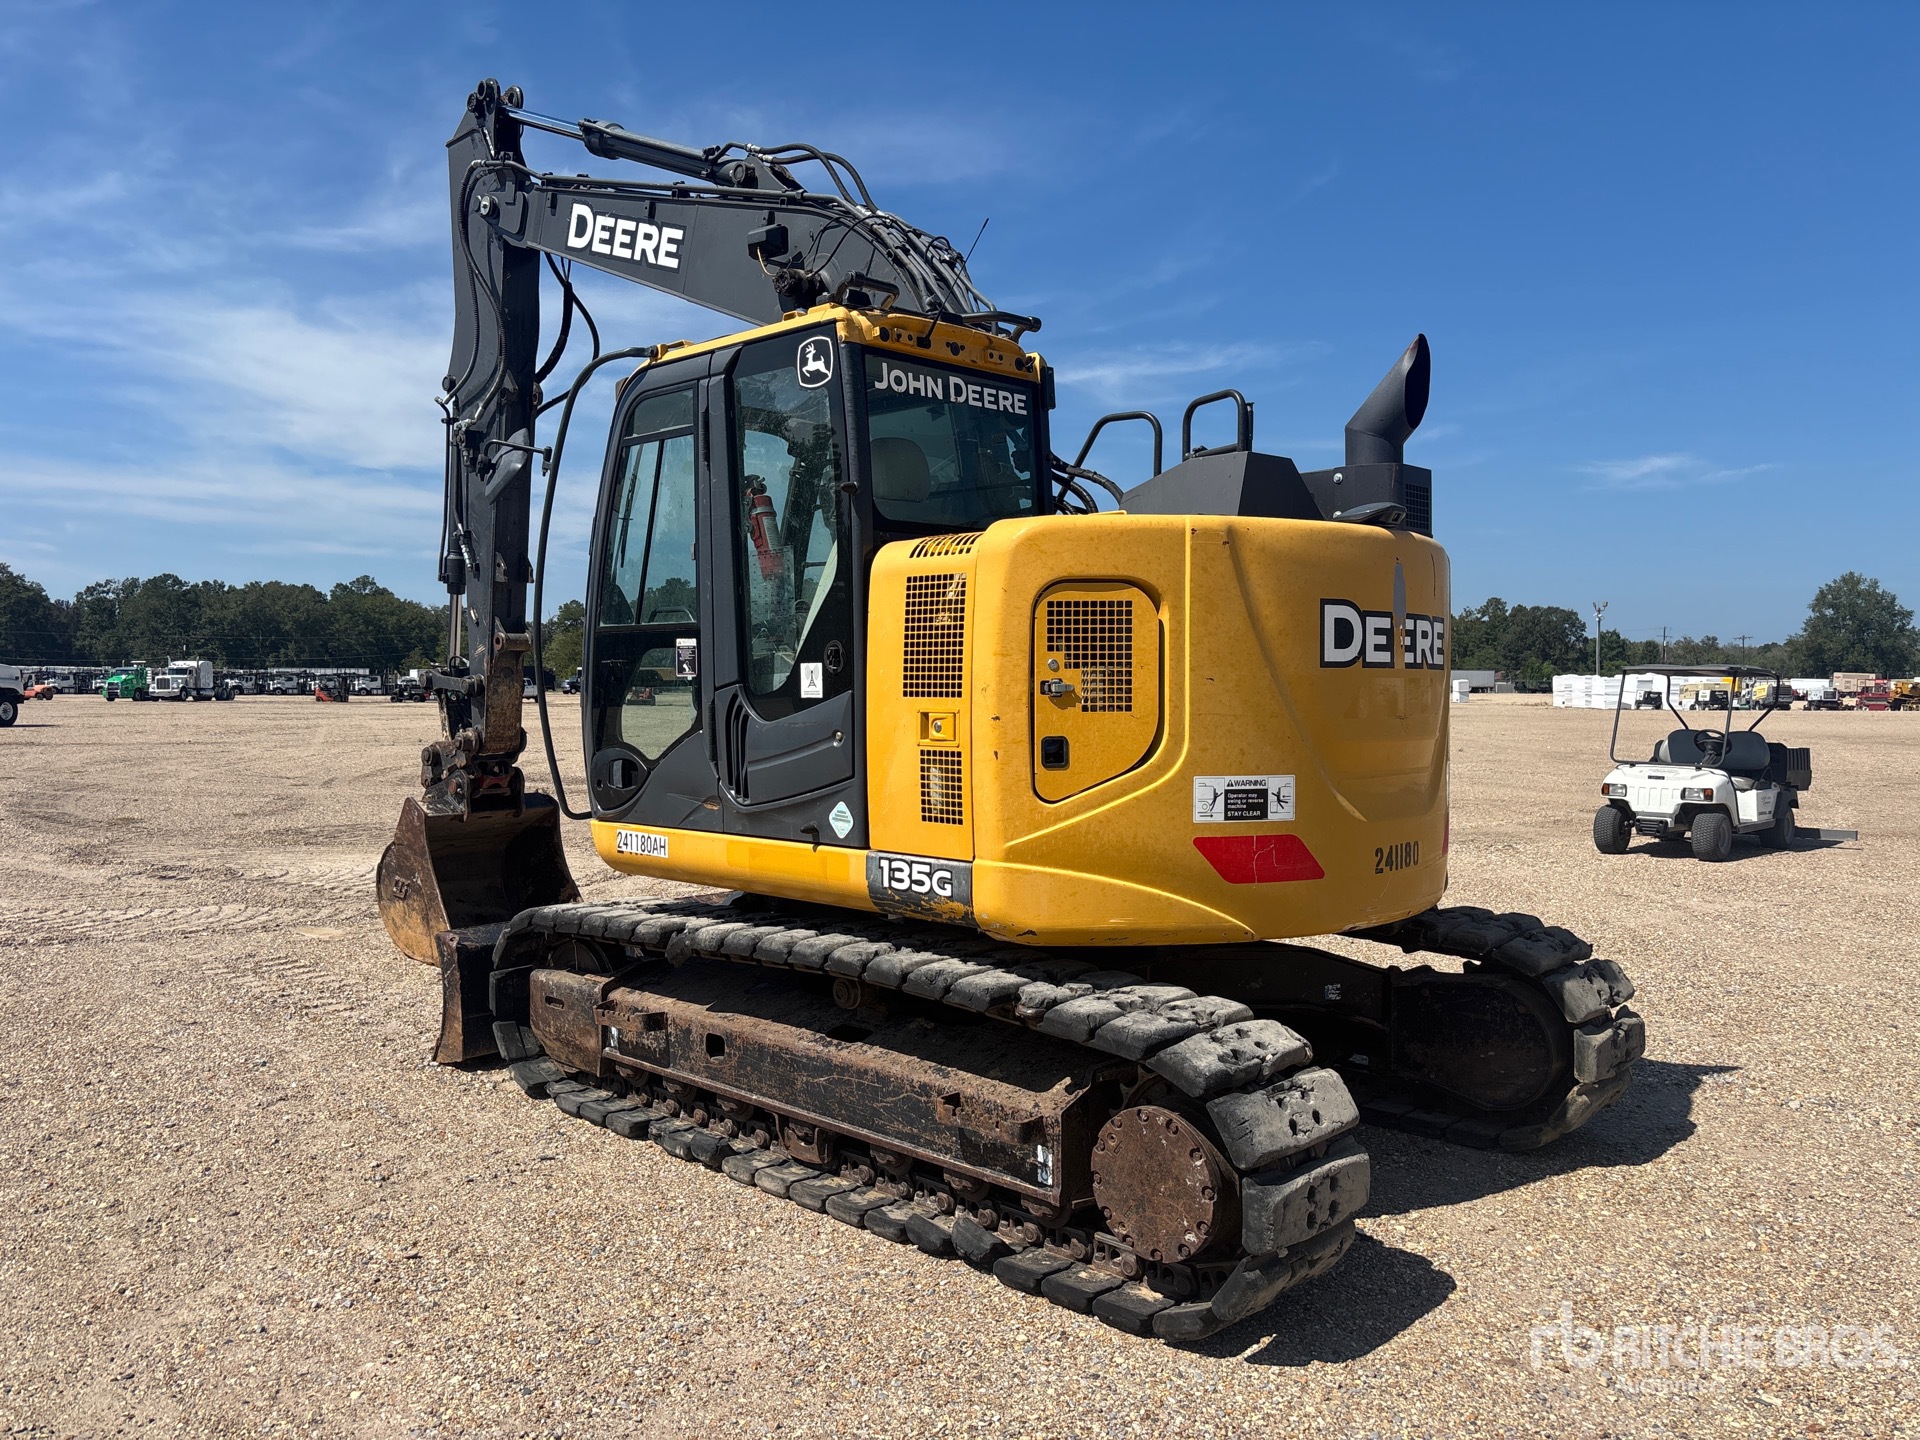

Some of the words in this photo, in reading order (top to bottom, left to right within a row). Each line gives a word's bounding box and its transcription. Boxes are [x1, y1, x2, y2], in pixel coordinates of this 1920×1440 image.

[567, 203, 684, 269] DEERE
[874, 362, 943, 400] JOHN
[949, 375, 1028, 416] DEERE
[1324, 604, 1444, 665] DEERE
[1234, 779, 1266, 787] WARNING
[617, 831, 666, 856] 241180AH
[1375, 841, 1419, 874] 241180
[879, 858, 953, 897] 135G
